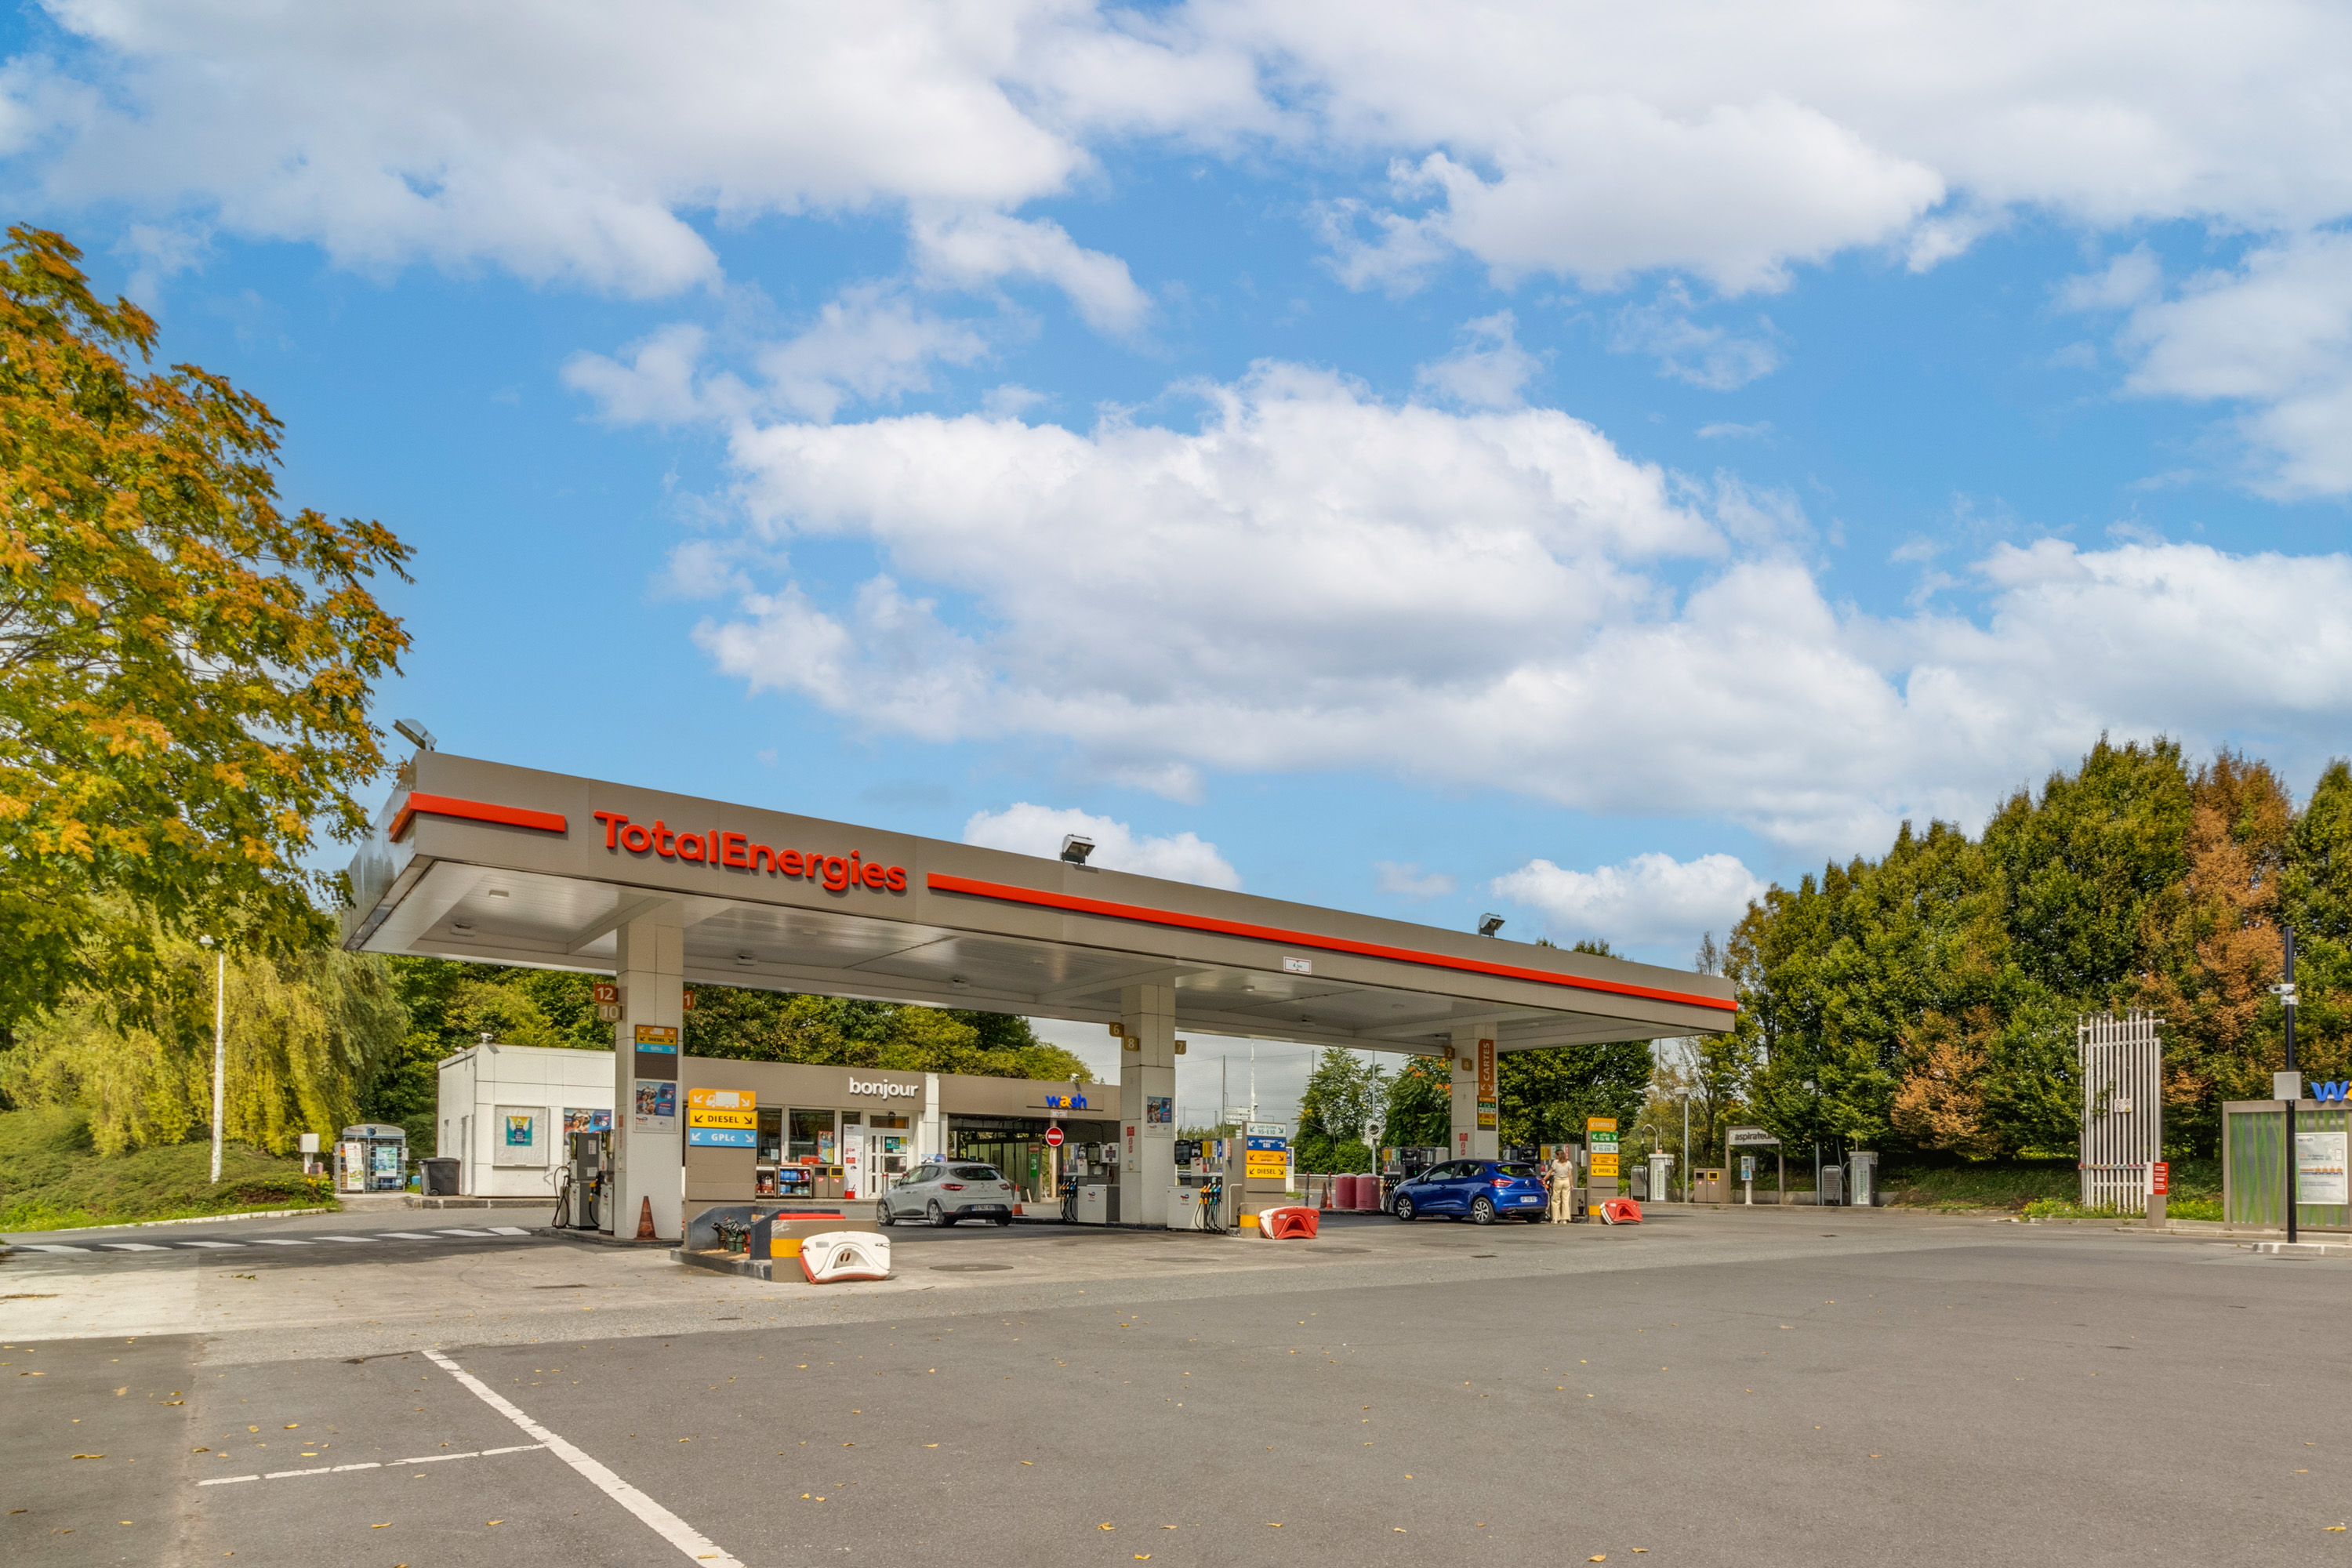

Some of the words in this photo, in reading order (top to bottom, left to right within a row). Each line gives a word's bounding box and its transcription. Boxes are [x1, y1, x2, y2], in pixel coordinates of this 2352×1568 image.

[593, 810, 906, 891] TotalEnergies
[597, 987, 614, 1000] 12
[601, 1004, 619, 1018] 10
[1113, 1025, 1120, 1035] 6
[1128, 1038, 1134, 1048] 8
[1178, 1042, 1183, 1052] 7
[1447, 1048, 1452, 1057] 2
[849, 1076, 919, 1100] bonjour
[2310, 1080, 2352, 1102] w
[1045, 1093, 1087, 1109] wash
[707, 1115, 739, 1123] DIESEL
[711, 1133, 735, 1142] GPLc
[1734, 1132, 1773, 1142] aspirateur
